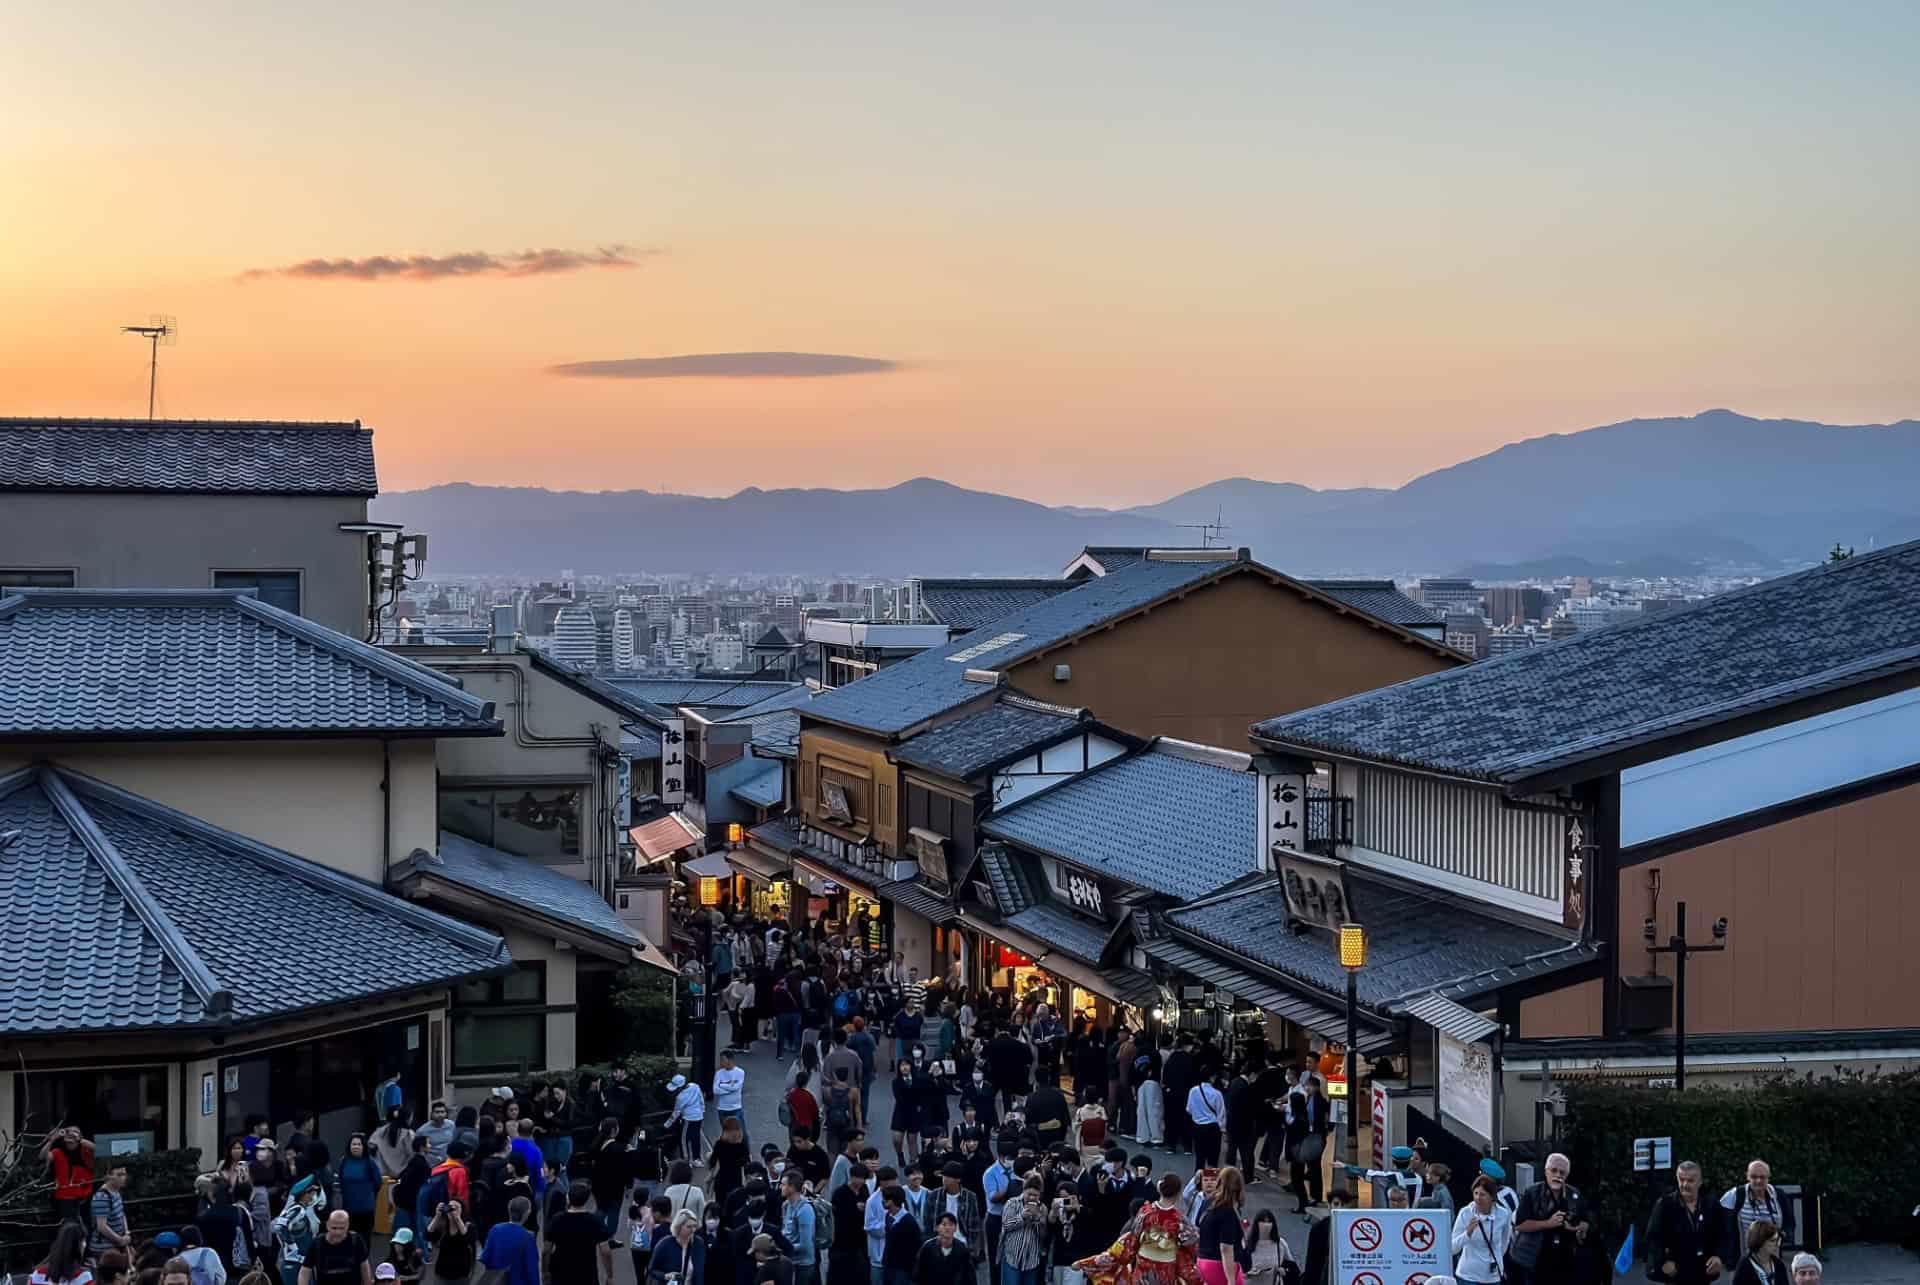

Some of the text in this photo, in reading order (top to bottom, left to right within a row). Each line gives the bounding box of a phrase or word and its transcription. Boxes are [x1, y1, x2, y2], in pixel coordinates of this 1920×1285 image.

[1567, 817, 1584, 919] 食事処
[1373, 1087, 1385, 1171] KIRI
